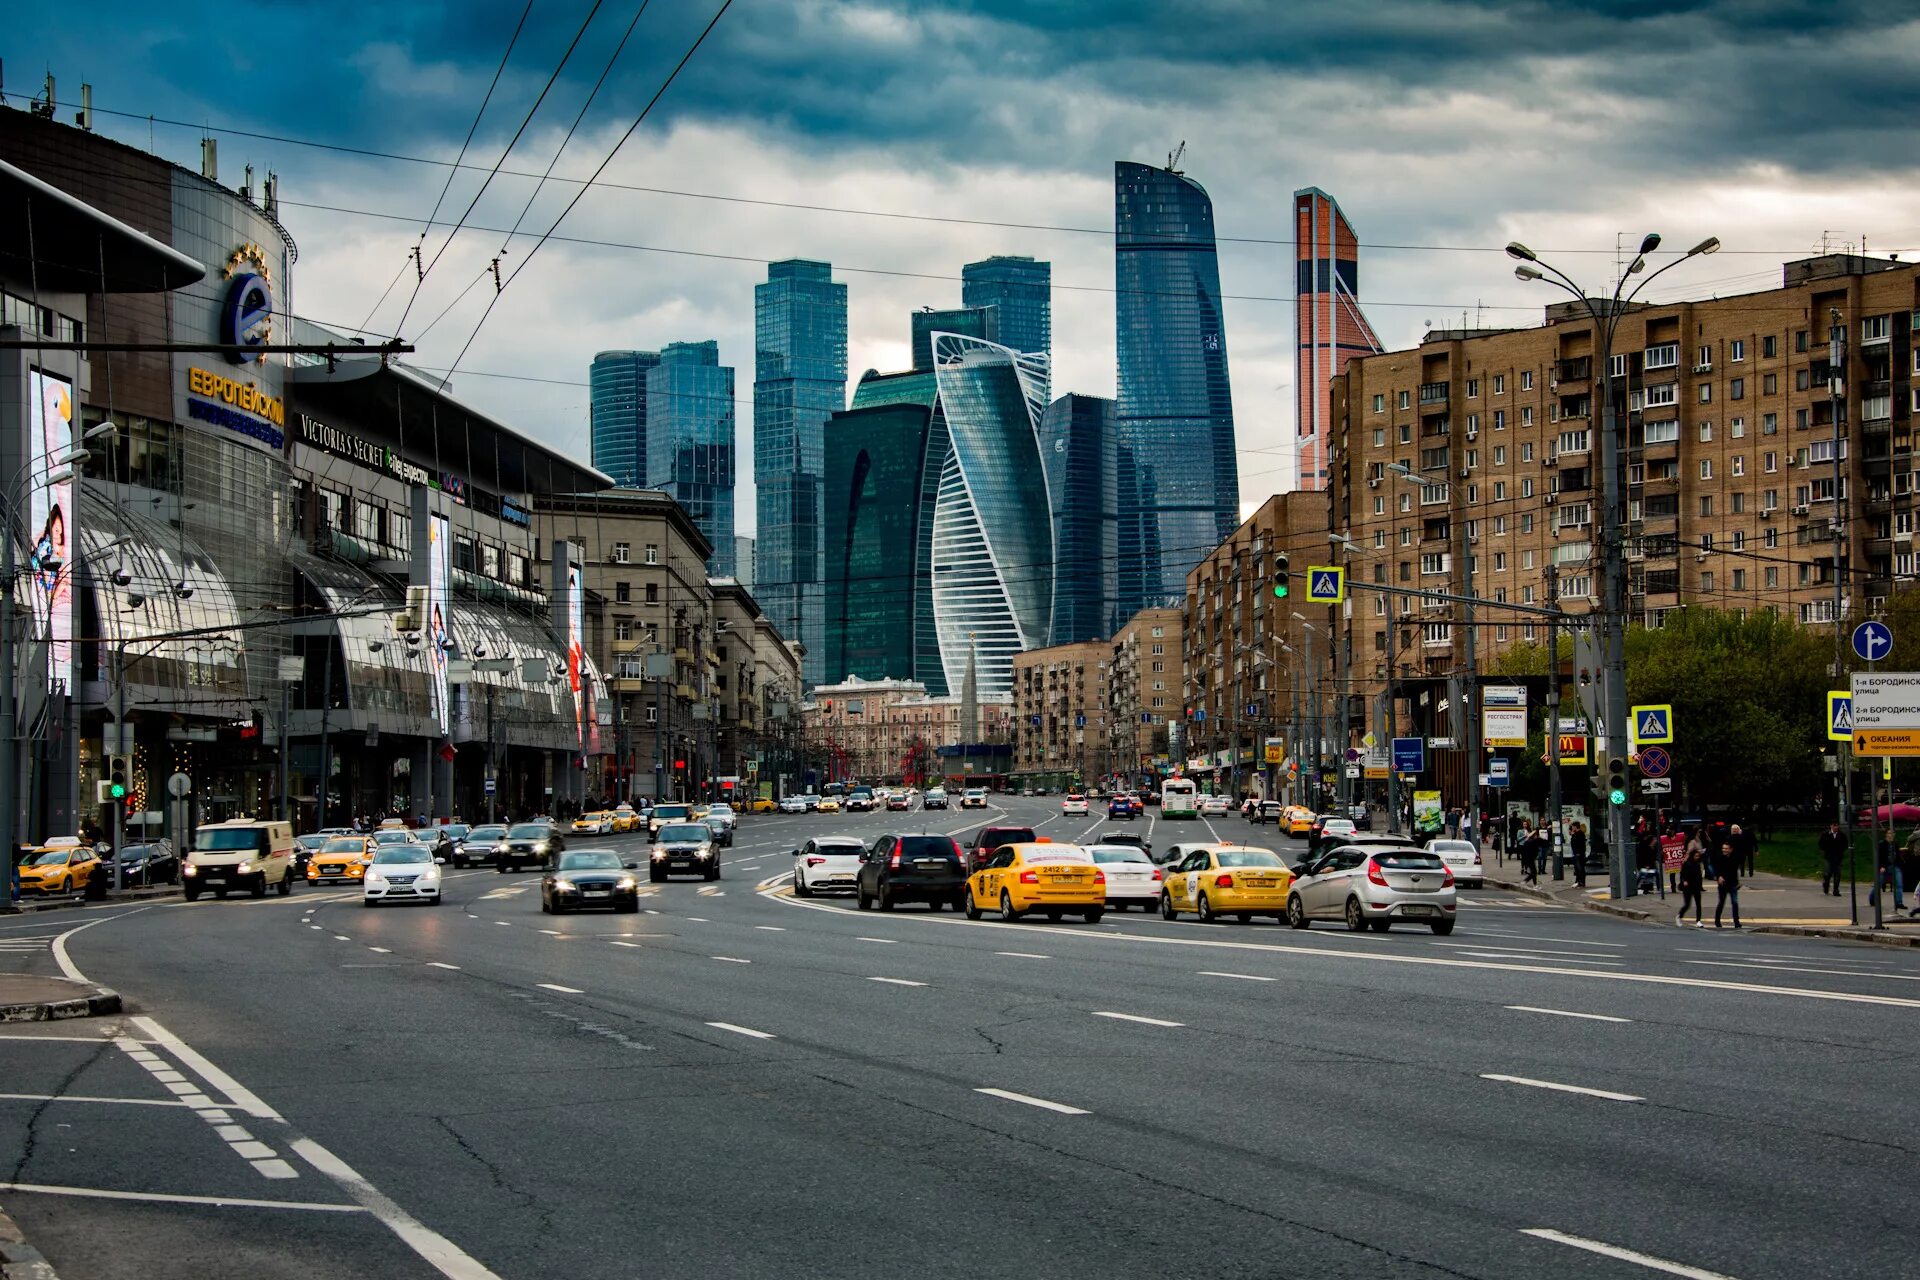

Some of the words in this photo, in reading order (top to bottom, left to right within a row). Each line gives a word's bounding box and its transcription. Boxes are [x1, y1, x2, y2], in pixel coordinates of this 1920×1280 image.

[188, 366, 285, 427] ЕВРОПЕЙСКИЙ
[1855, 706, 1868, 714] 2-я
[1870, 735, 1911, 743] ОКЕАНИЯ
